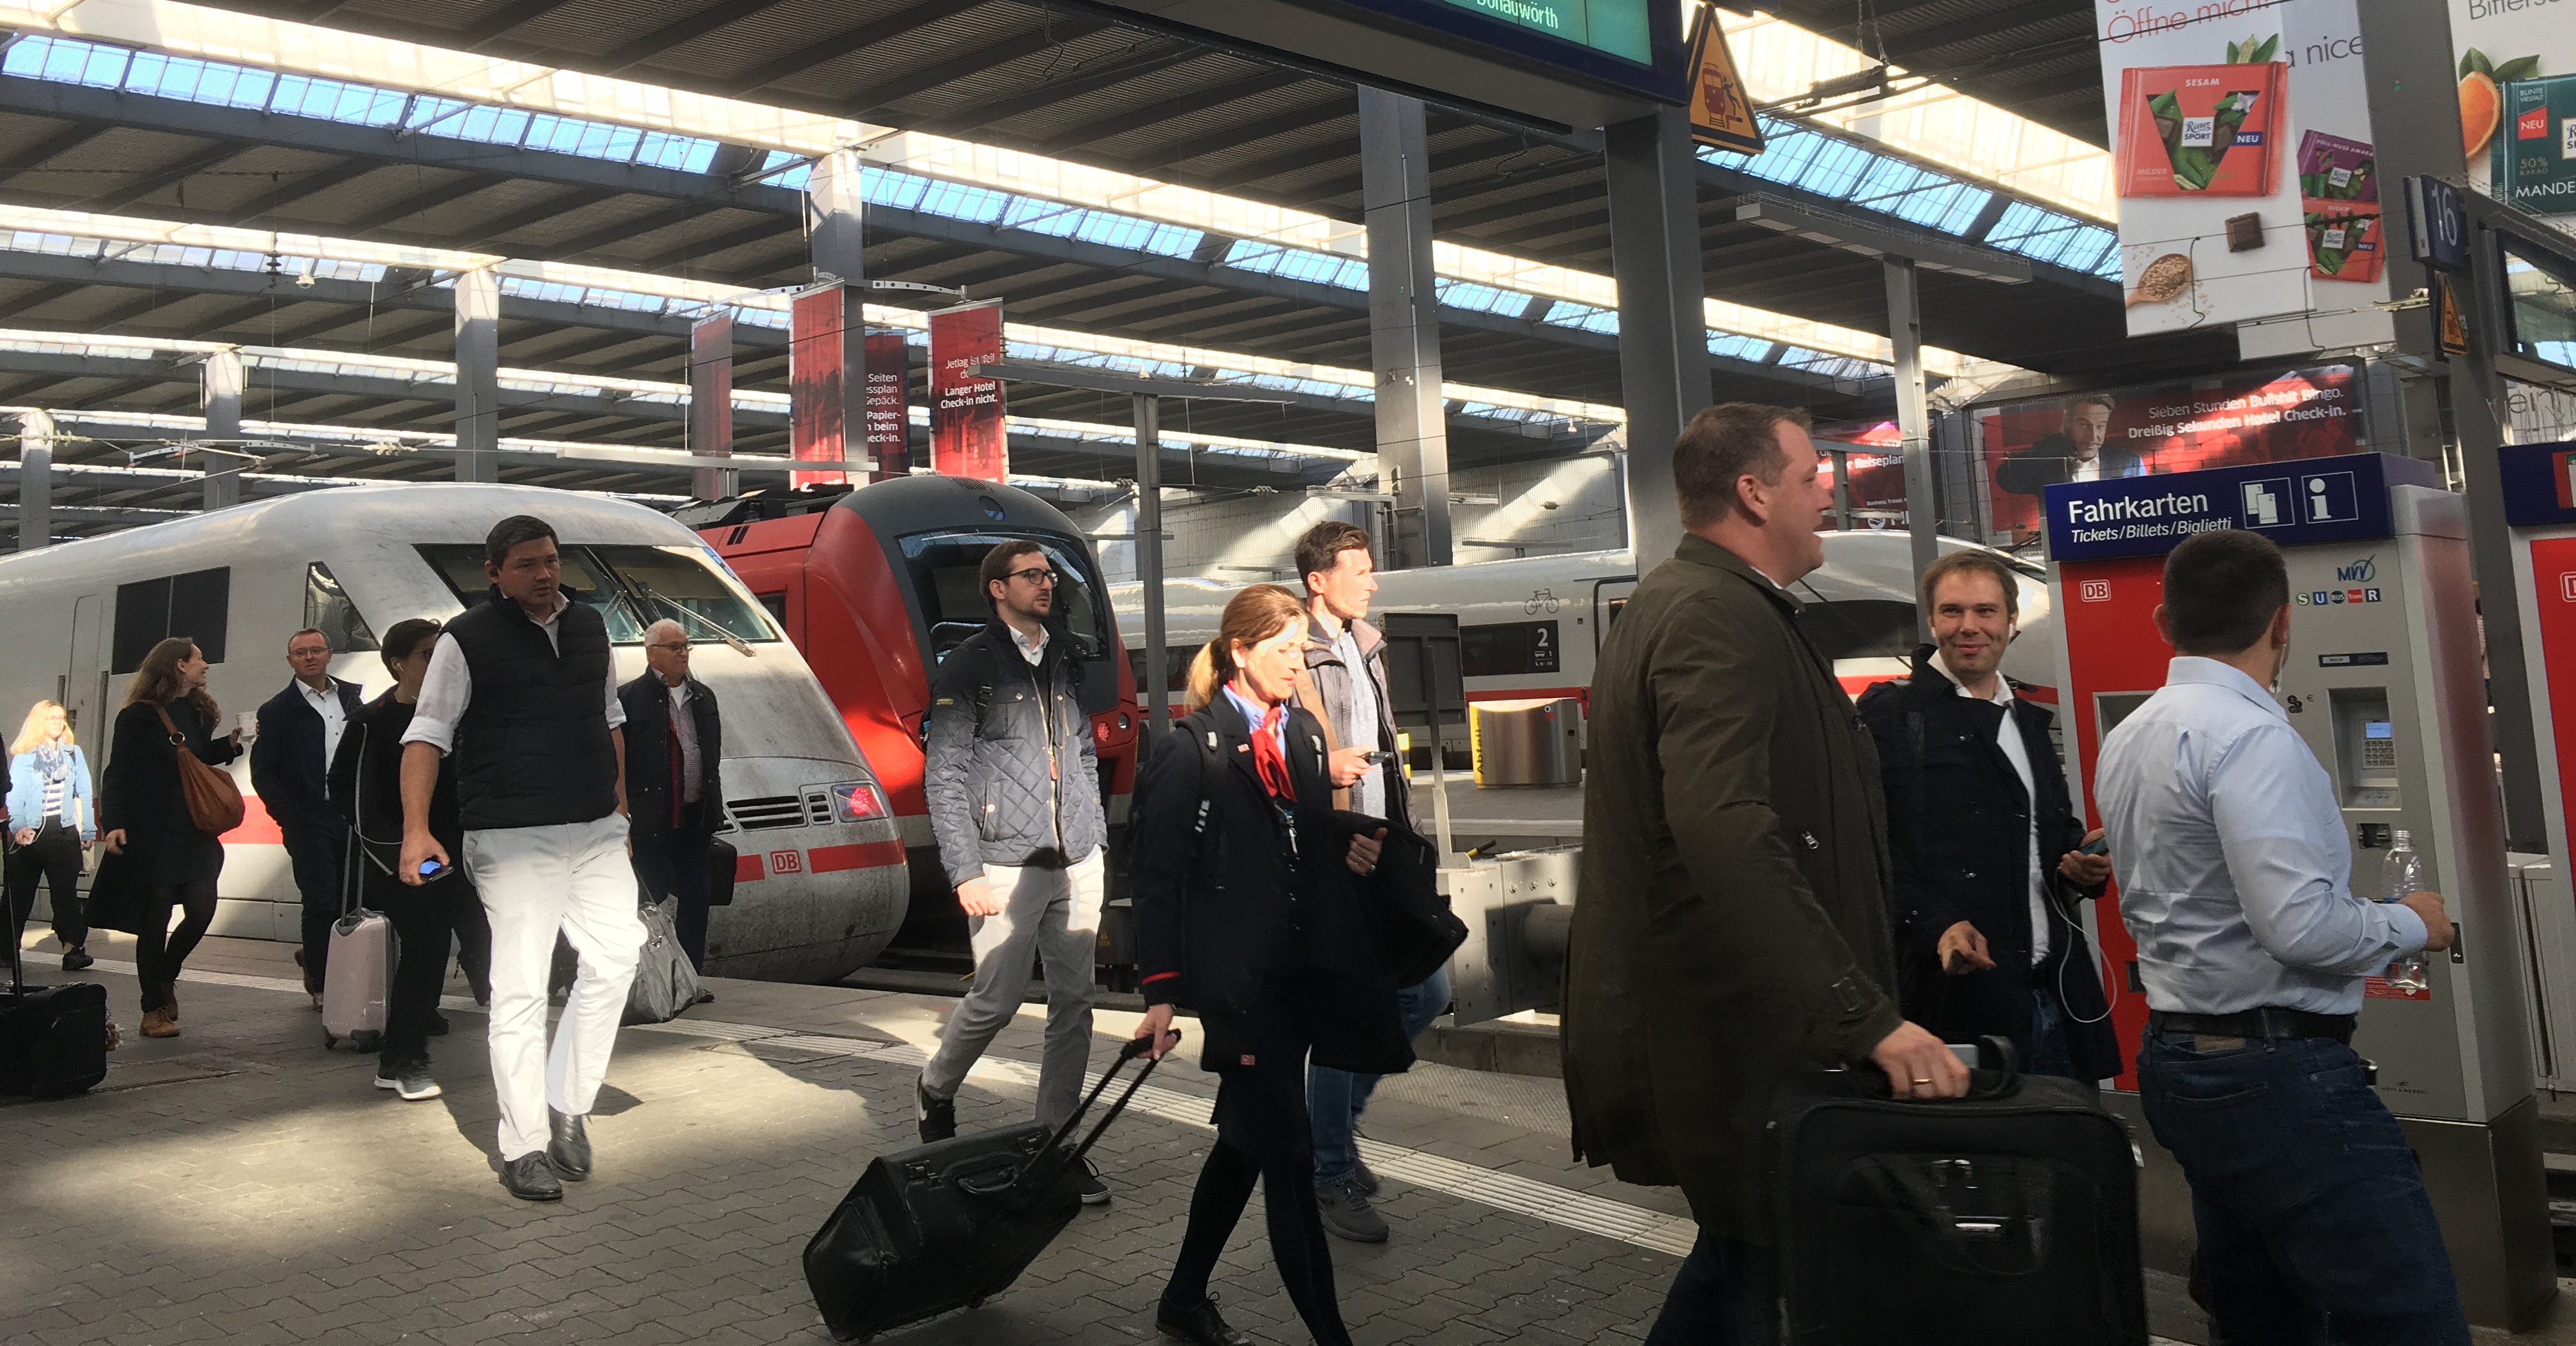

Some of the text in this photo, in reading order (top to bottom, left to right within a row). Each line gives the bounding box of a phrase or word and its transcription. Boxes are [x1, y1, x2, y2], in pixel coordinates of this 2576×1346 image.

[1477, 0, 1558, 29] onauwörth
[2108, 6, 2188, 43] Öffne
[2306, 36, 2363, 65] nice
[2185, 78, 2220, 86] SESAM
[2520, 88, 2543, 96] BUNTE
[2521, 120, 2544, 130] NEU
[2520, 157, 2548, 169] 50%
[2515, 182, 2575, 197] MANDE
[2432, 183, 2457, 246] 16
[946, 359, 969, 369] Jetlag
[970, 357, 979, 366] ist
[868, 373, 897, 382] Seiten
[946, 381, 995, 396] Langer Hotel
[940, 394, 998, 409] Check-in nicht.
[2149, 387, 2344, 419] Sieben Stunden Bullshit Bingo.
[866, 410, 901, 421] Papier-
[2128, 405, 2347, 439] Dreißig Sekunden Hotel Check-in.
[874, 422, 898, 431] beim
[2069, 492, 2208, 523] Fahrkarten
[2083, 582, 2108, 599] DB
[2332, 593, 2345, 601] BUS
[2368, 590, 2378, 601] R
[1537, 628, 1548, 647] 2
[1475, 729, 1484, 775] Abfall
[774, 853, 798, 870] DB
